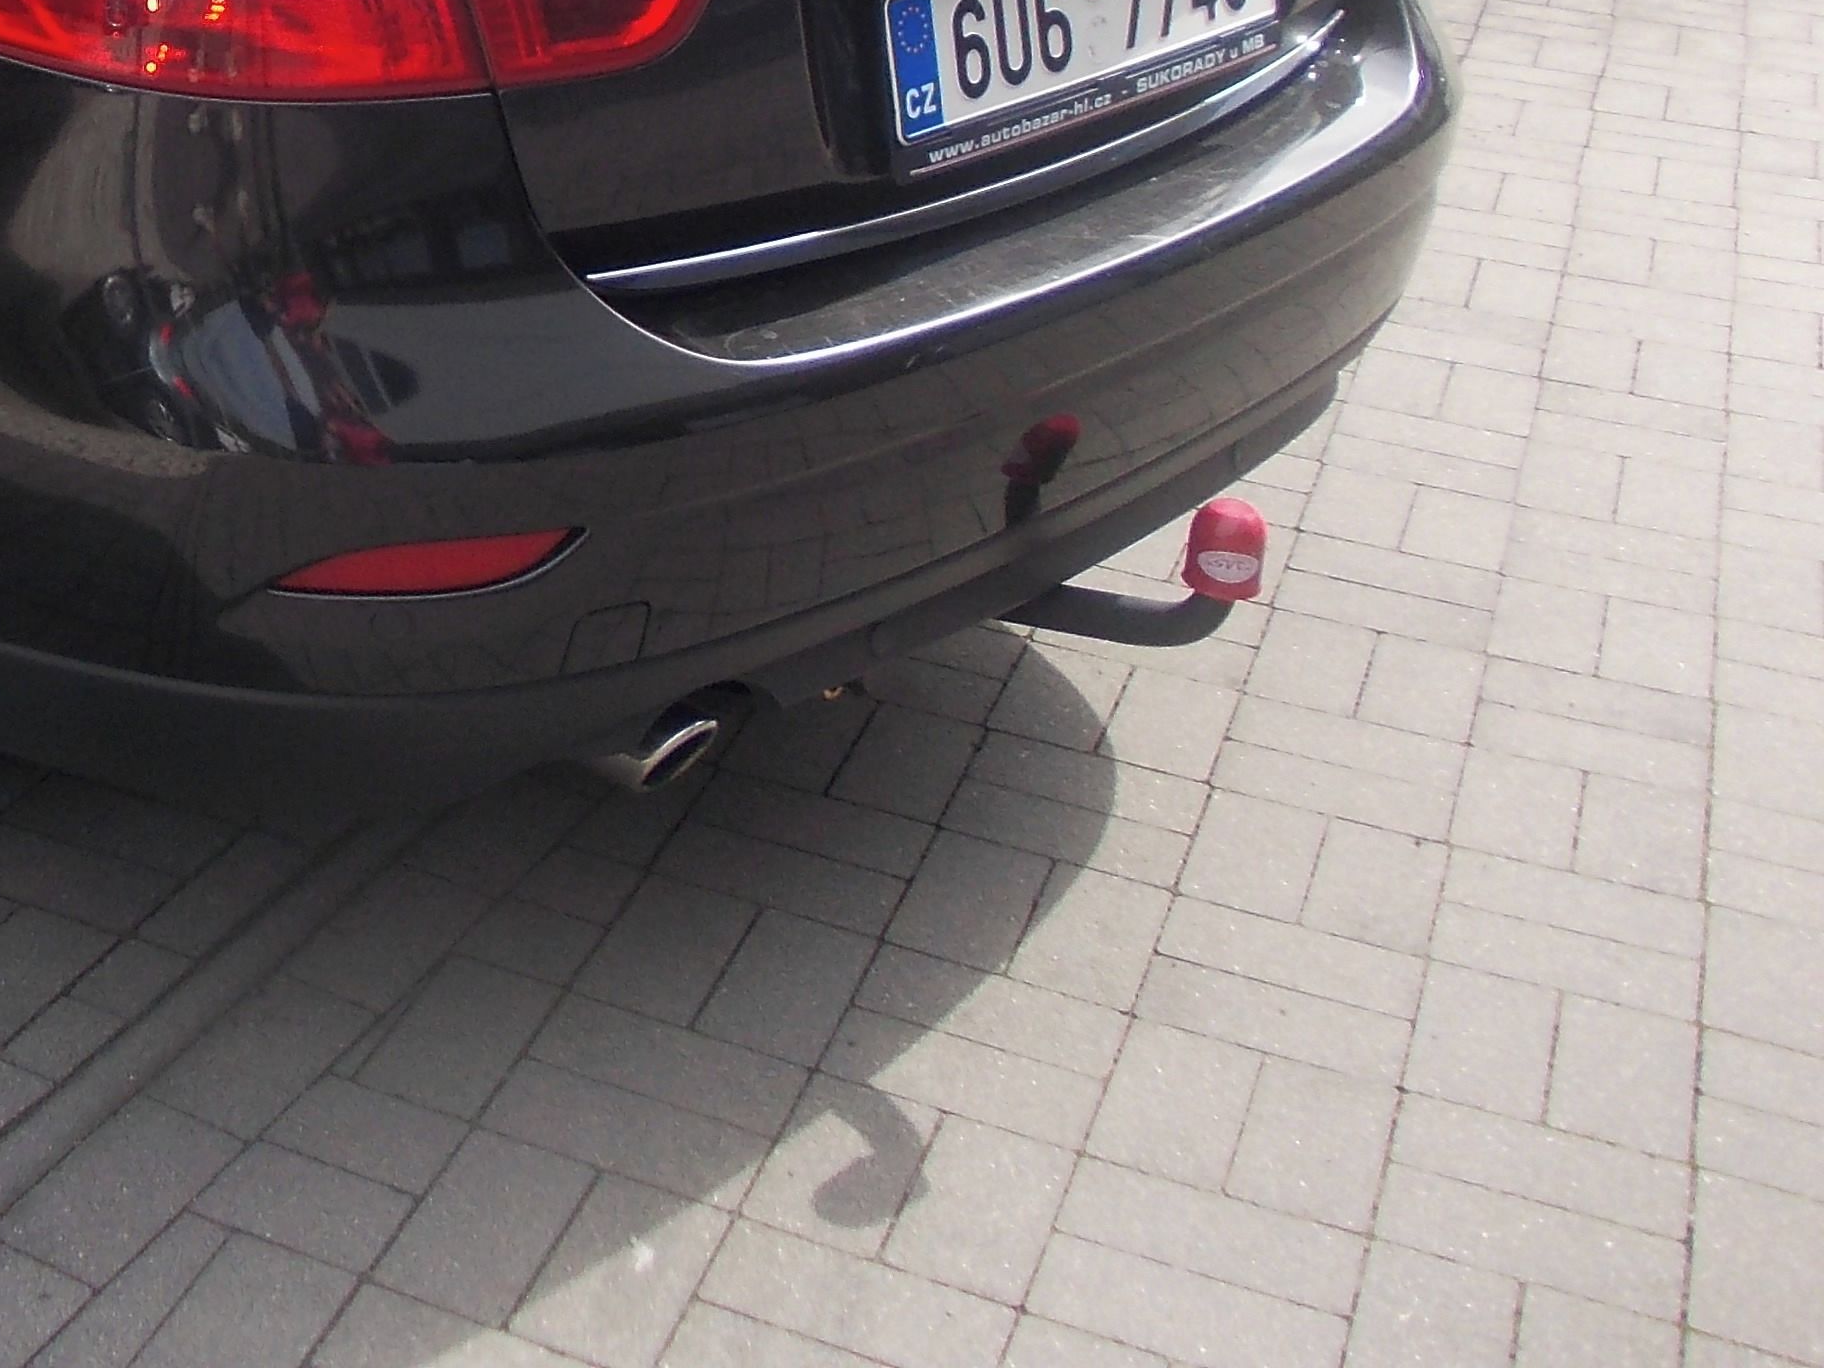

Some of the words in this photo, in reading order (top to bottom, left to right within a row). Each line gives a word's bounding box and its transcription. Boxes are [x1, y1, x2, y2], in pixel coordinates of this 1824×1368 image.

[905, 81, 937, 120] CZ
[928, 92, 1113, 163] www.autobazar-hl.cz
[1136, 48, 1226, 93] SUKORADY
[1229, 47, 1239, 59] u
[1242, 33, 1265, 54] MB
